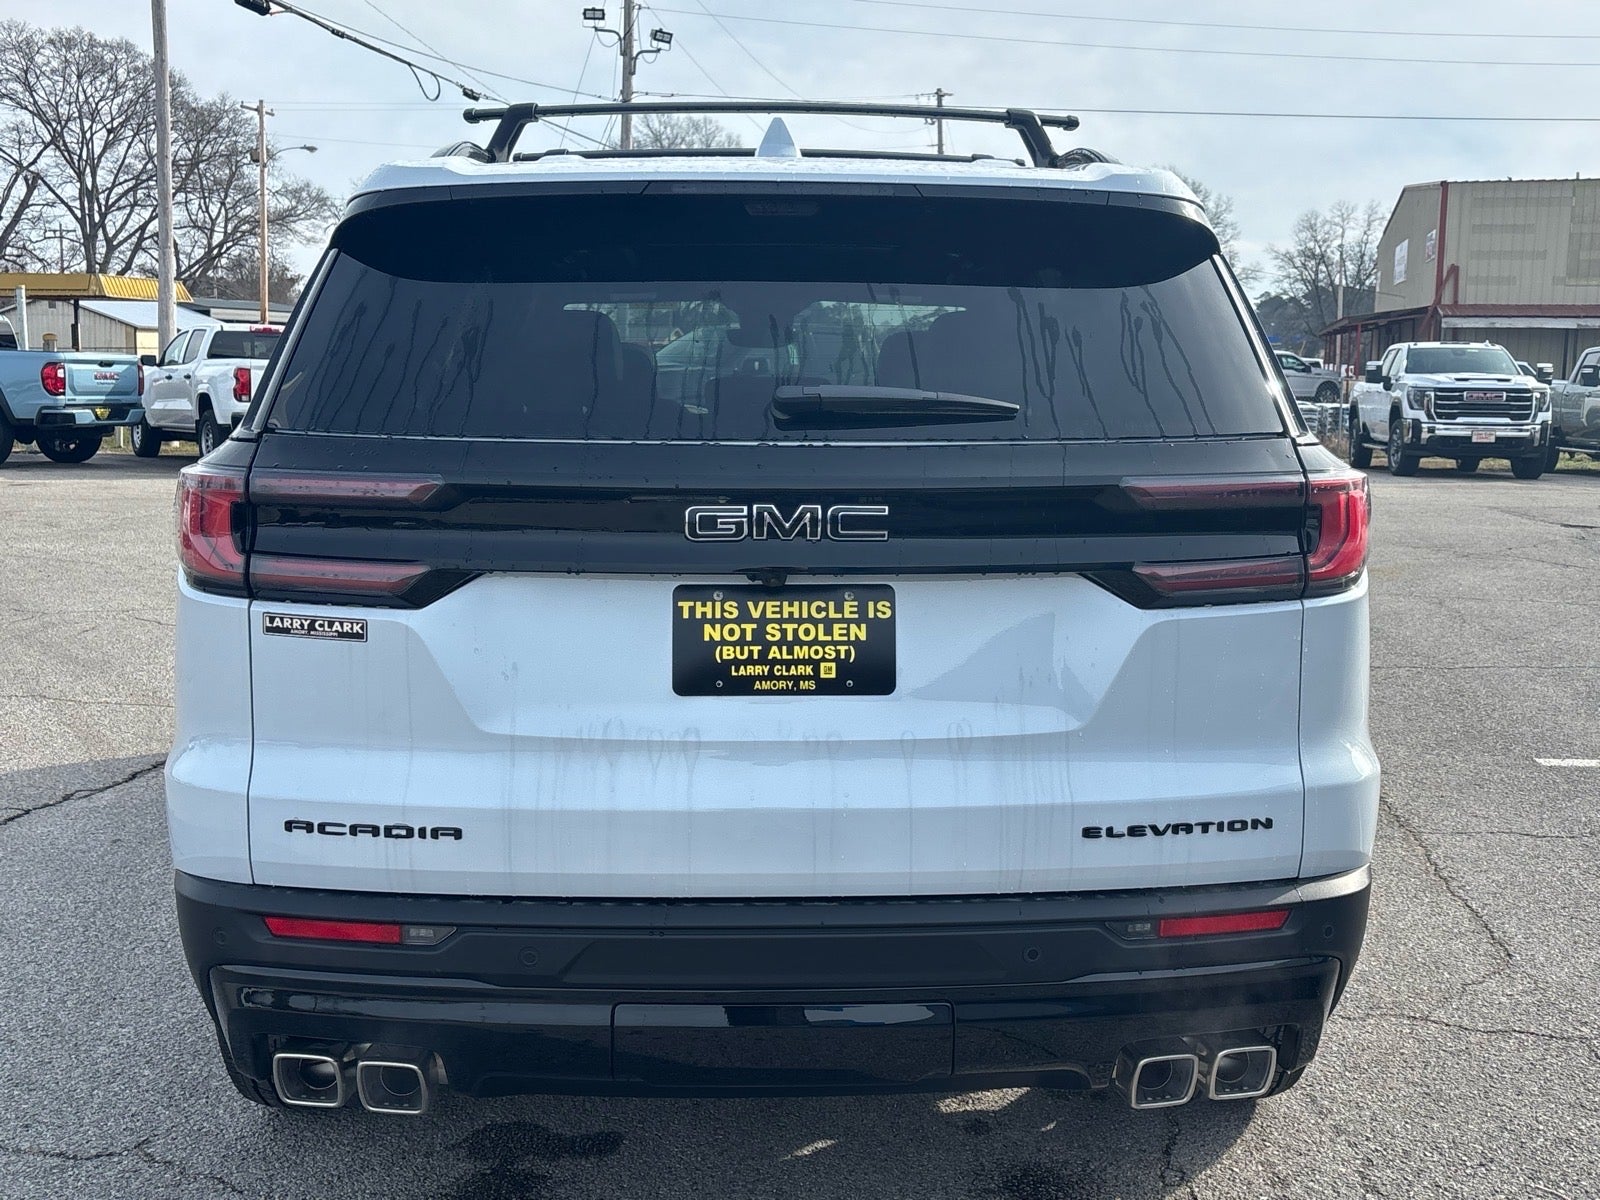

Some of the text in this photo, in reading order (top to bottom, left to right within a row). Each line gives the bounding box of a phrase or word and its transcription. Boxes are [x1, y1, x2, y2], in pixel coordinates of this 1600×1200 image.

[685, 504, 889, 541] GMC
[677, 601, 892, 619] THIS VEHICLE IS
[265, 616, 364, 634] LARRY CLARK
[703, 623, 867, 641] NOT STOLEN
[715, 645, 856, 663] (BUT ALMOST)
[731, 665, 770, 676] LARRY
[773, 665, 814, 676] CLARK
[754, 680, 816, 691] AMORY, MS
[284, 819, 463, 841] ACADIA
[1081, 817, 1274, 839] ELEVATION
